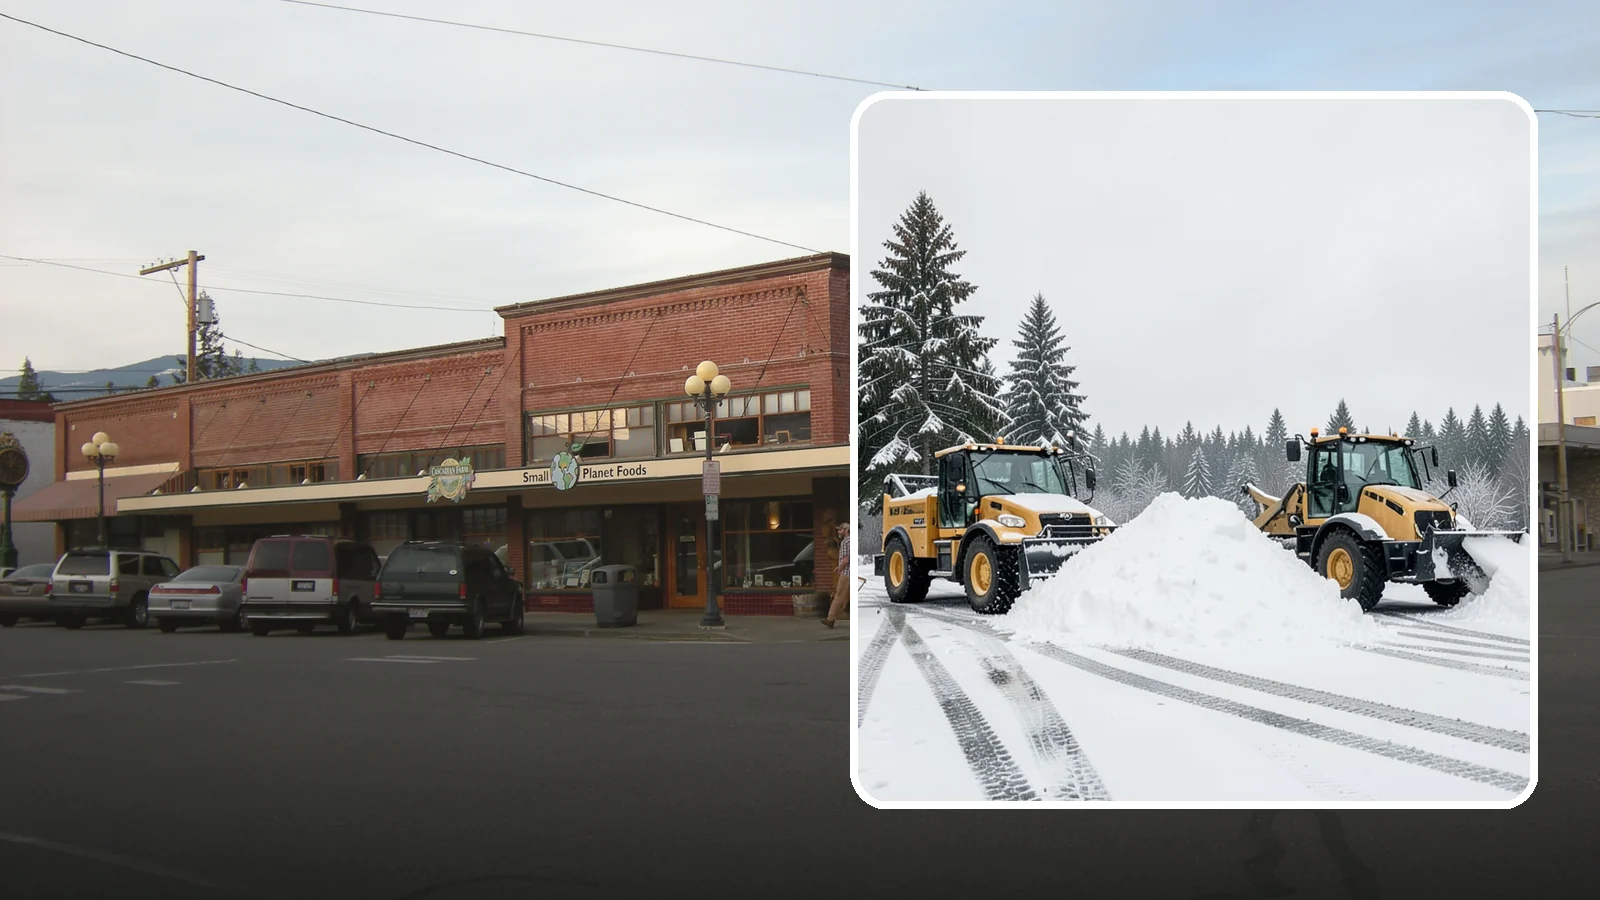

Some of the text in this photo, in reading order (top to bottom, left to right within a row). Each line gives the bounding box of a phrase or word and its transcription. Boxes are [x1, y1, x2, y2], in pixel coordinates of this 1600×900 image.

[523, 464, 646, 482] Small Planet Foods
